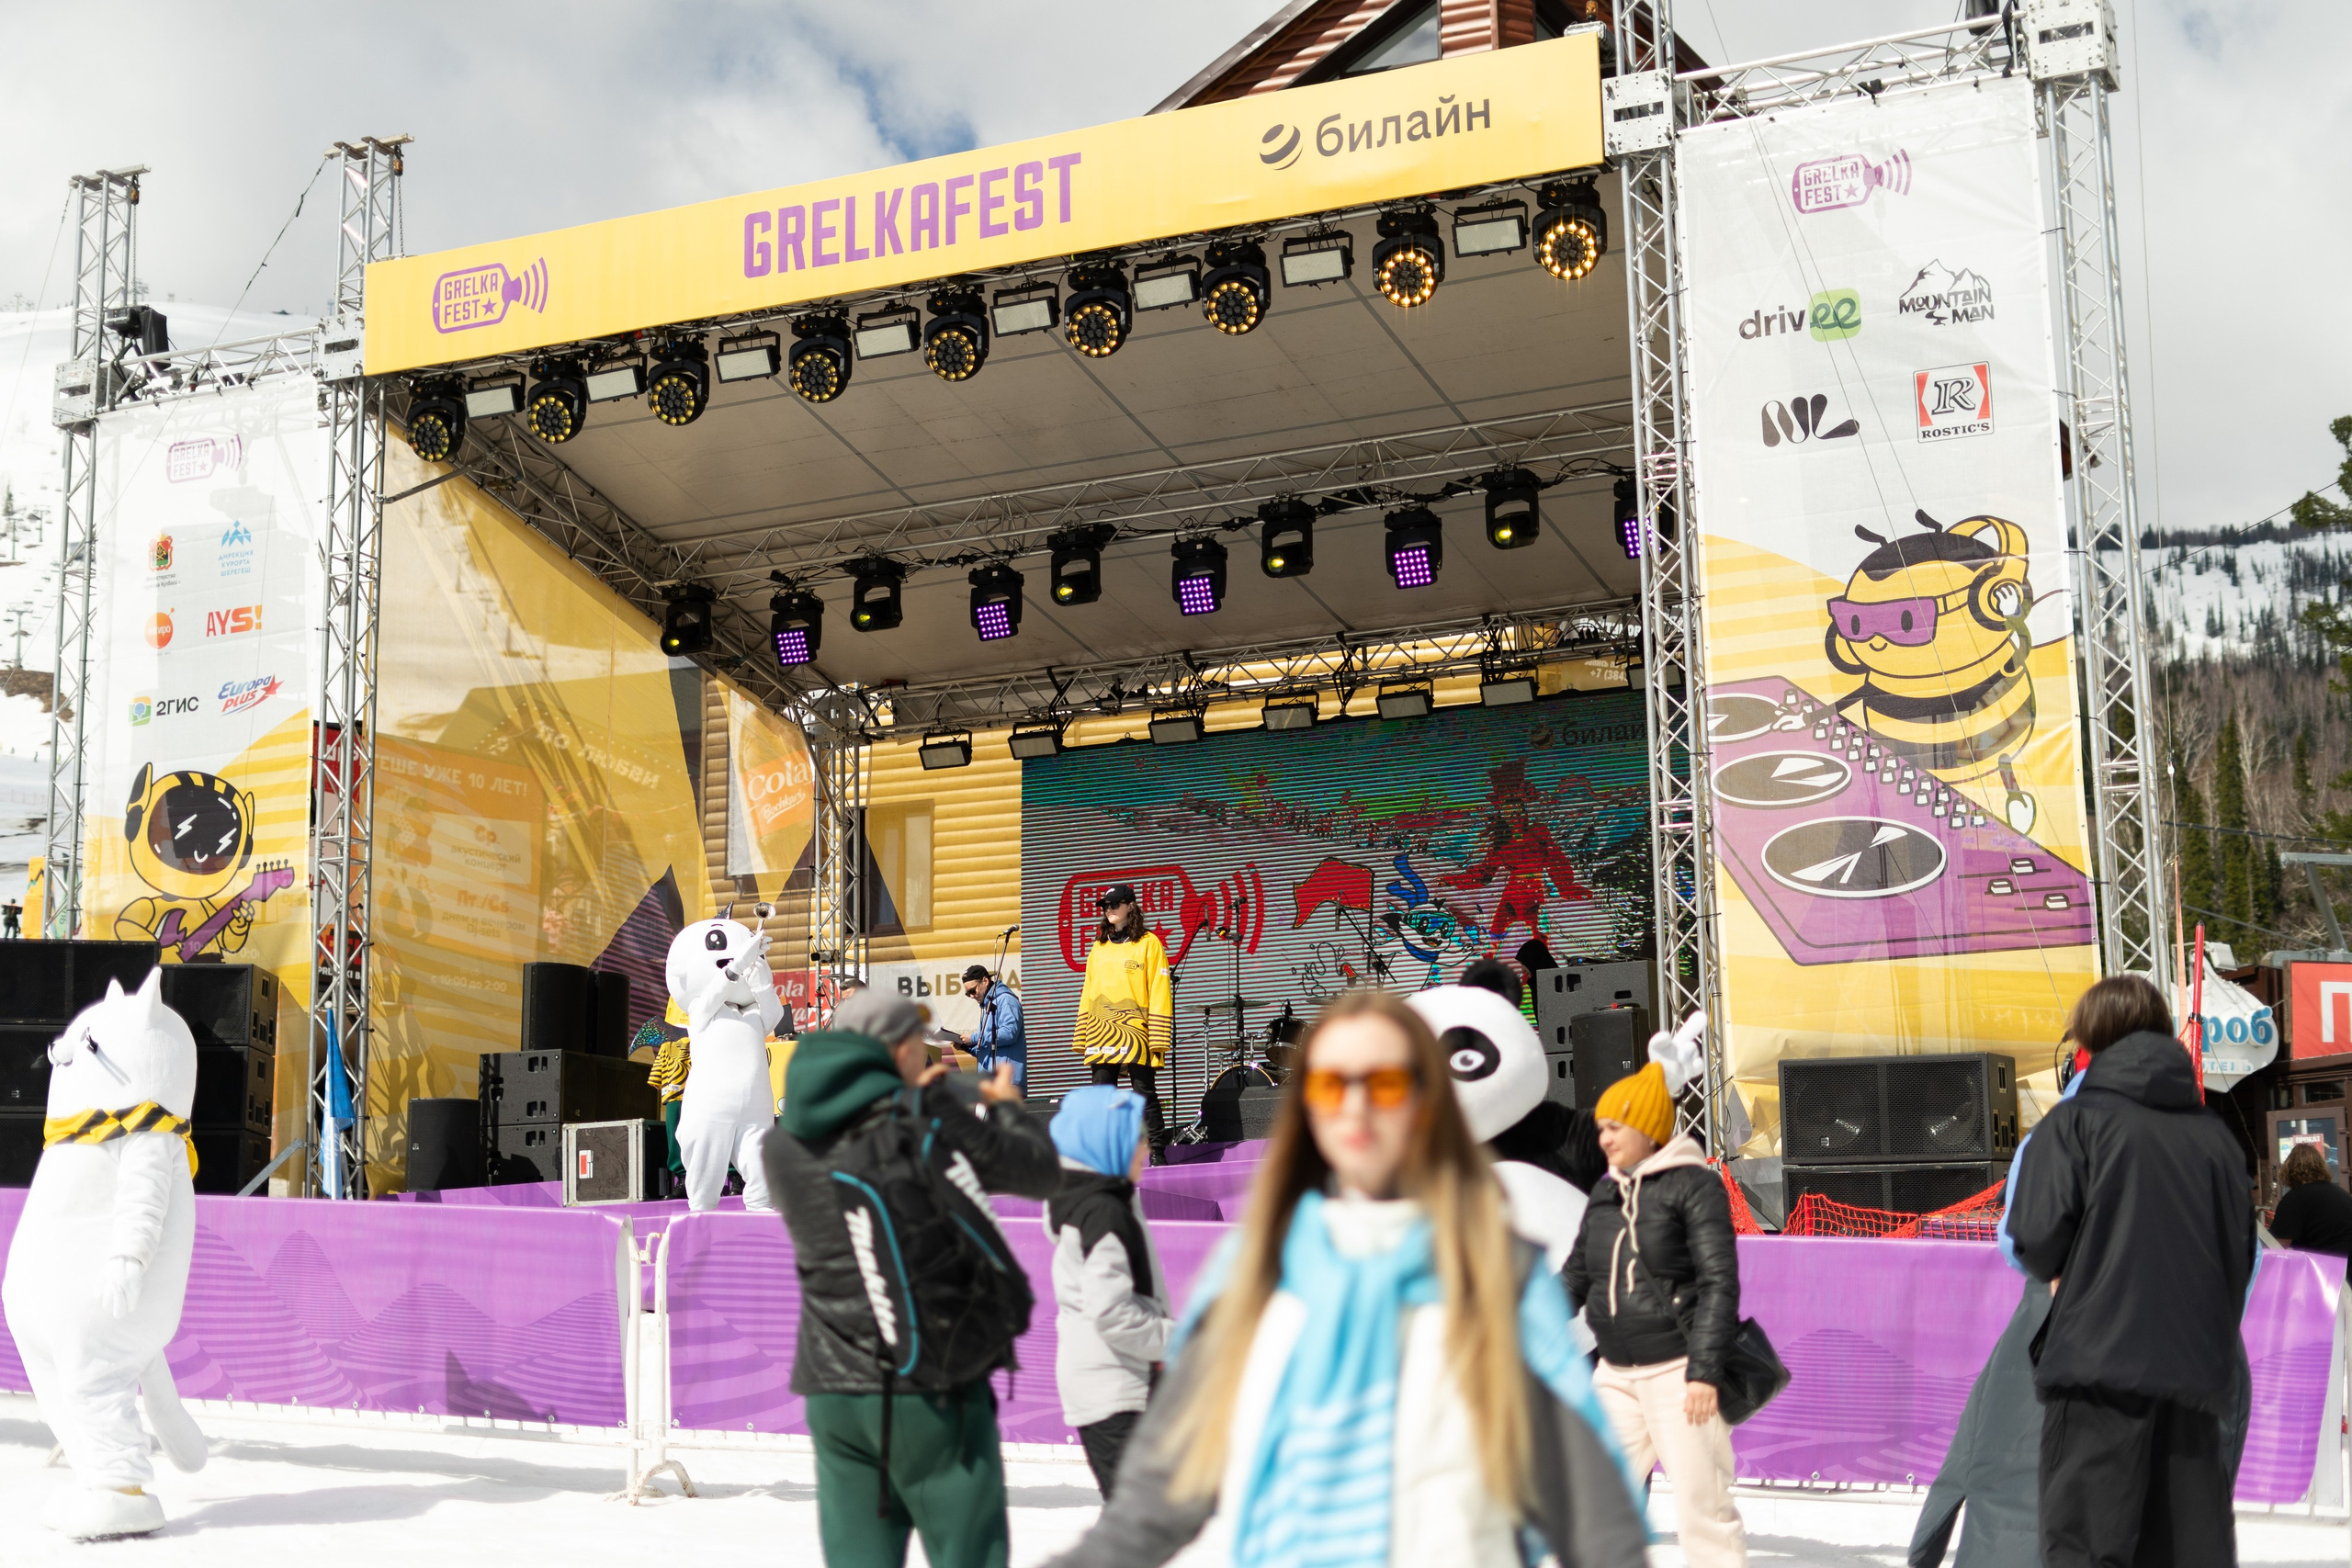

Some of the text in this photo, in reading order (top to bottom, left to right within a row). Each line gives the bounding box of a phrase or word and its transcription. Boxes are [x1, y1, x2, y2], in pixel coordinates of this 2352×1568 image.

[1316, 95, 1492, 157] билайн
[1804, 162, 1860, 186] GRELKA
[1805, 185, 1842, 206] FEST
[743, 152, 1082, 279] GRELKAFEST
[445, 272, 499, 301] GRELKA
[445, 299, 481, 324] FEST
[1899, 288, 1992, 314] MOUNTAIN
[1738, 297, 1862, 341] drivee
[1952, 304, 1995, 324] MAN
[1921, 423, 1990, 438] ROSTIC'S
[174, 444, 210, 462] GRELKA
[174, 460, 198, 478] FEST
[218, 550, 254, 561] ДИРЕКЦИЯ
[221, 559, 251, 569] КУРОРТА
[220, 567, 251, 577] ШЕРЕГЕШ
[206, 604, 263, 637] AYS!
[156, 696, 198, 716] 2ГИС
[423, 763, 462, 784] УЖЕ
[468, 773, 485, 789] 10
[490, 776, 529, 797] ЛЕТ!
[748, 760, 809, 802] Cola
[450, 844, 522, 863] акустический
[464, 858, 508, 872] концерт
